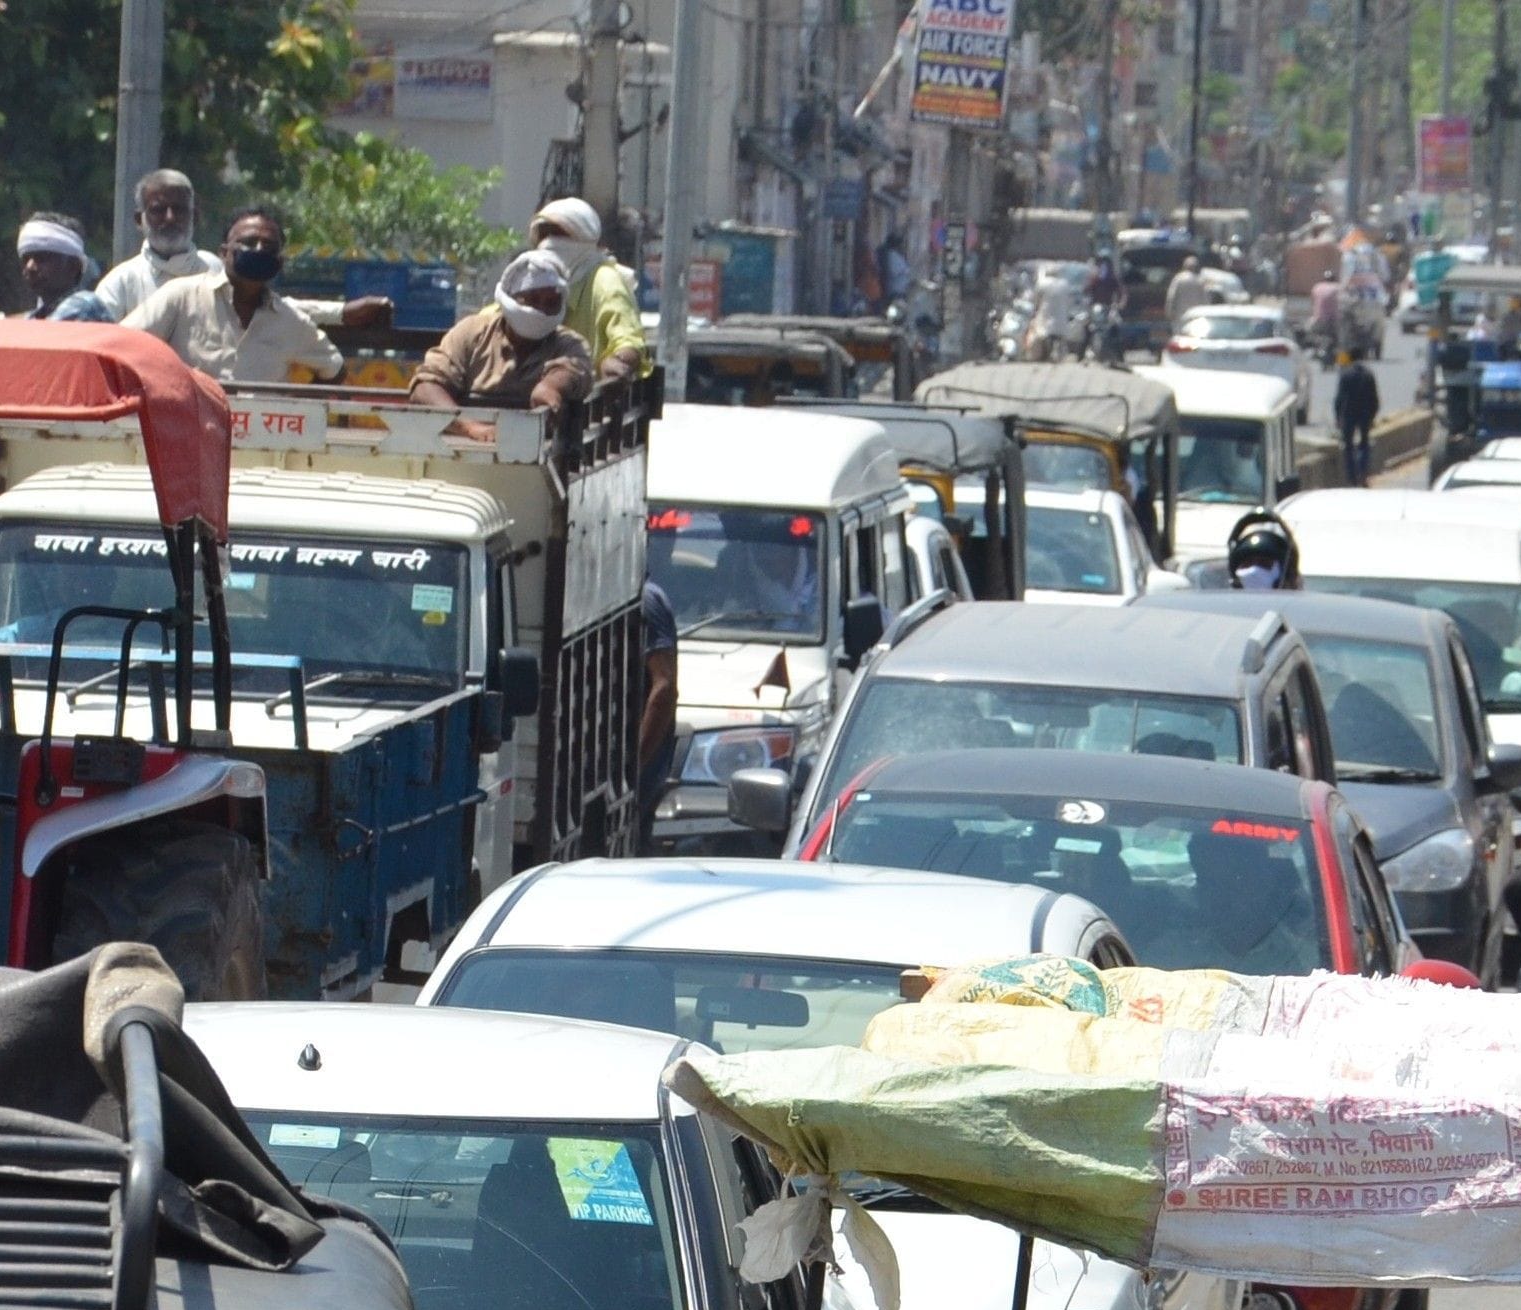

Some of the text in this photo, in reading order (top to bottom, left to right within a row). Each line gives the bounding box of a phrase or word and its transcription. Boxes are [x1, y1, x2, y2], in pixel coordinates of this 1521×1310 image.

[920, 30, 1006, 58] AIR FORCE
[919, 63, 998, 89] NAVY
[34, 533, 93, 554] बाबा
[230, 544, 289, 564] बाबा
[371, 548, 431, 572] चारी
[1211, 819, 1300, 842] ARMY
[1197, 1187, 1289, 1209] SHREE
[1295, 1187, 1355, 1210] RAM
[1362, 1186, 1439, 1208] BHOG
[572, 1202, 652, 1223] VIP PARKING
